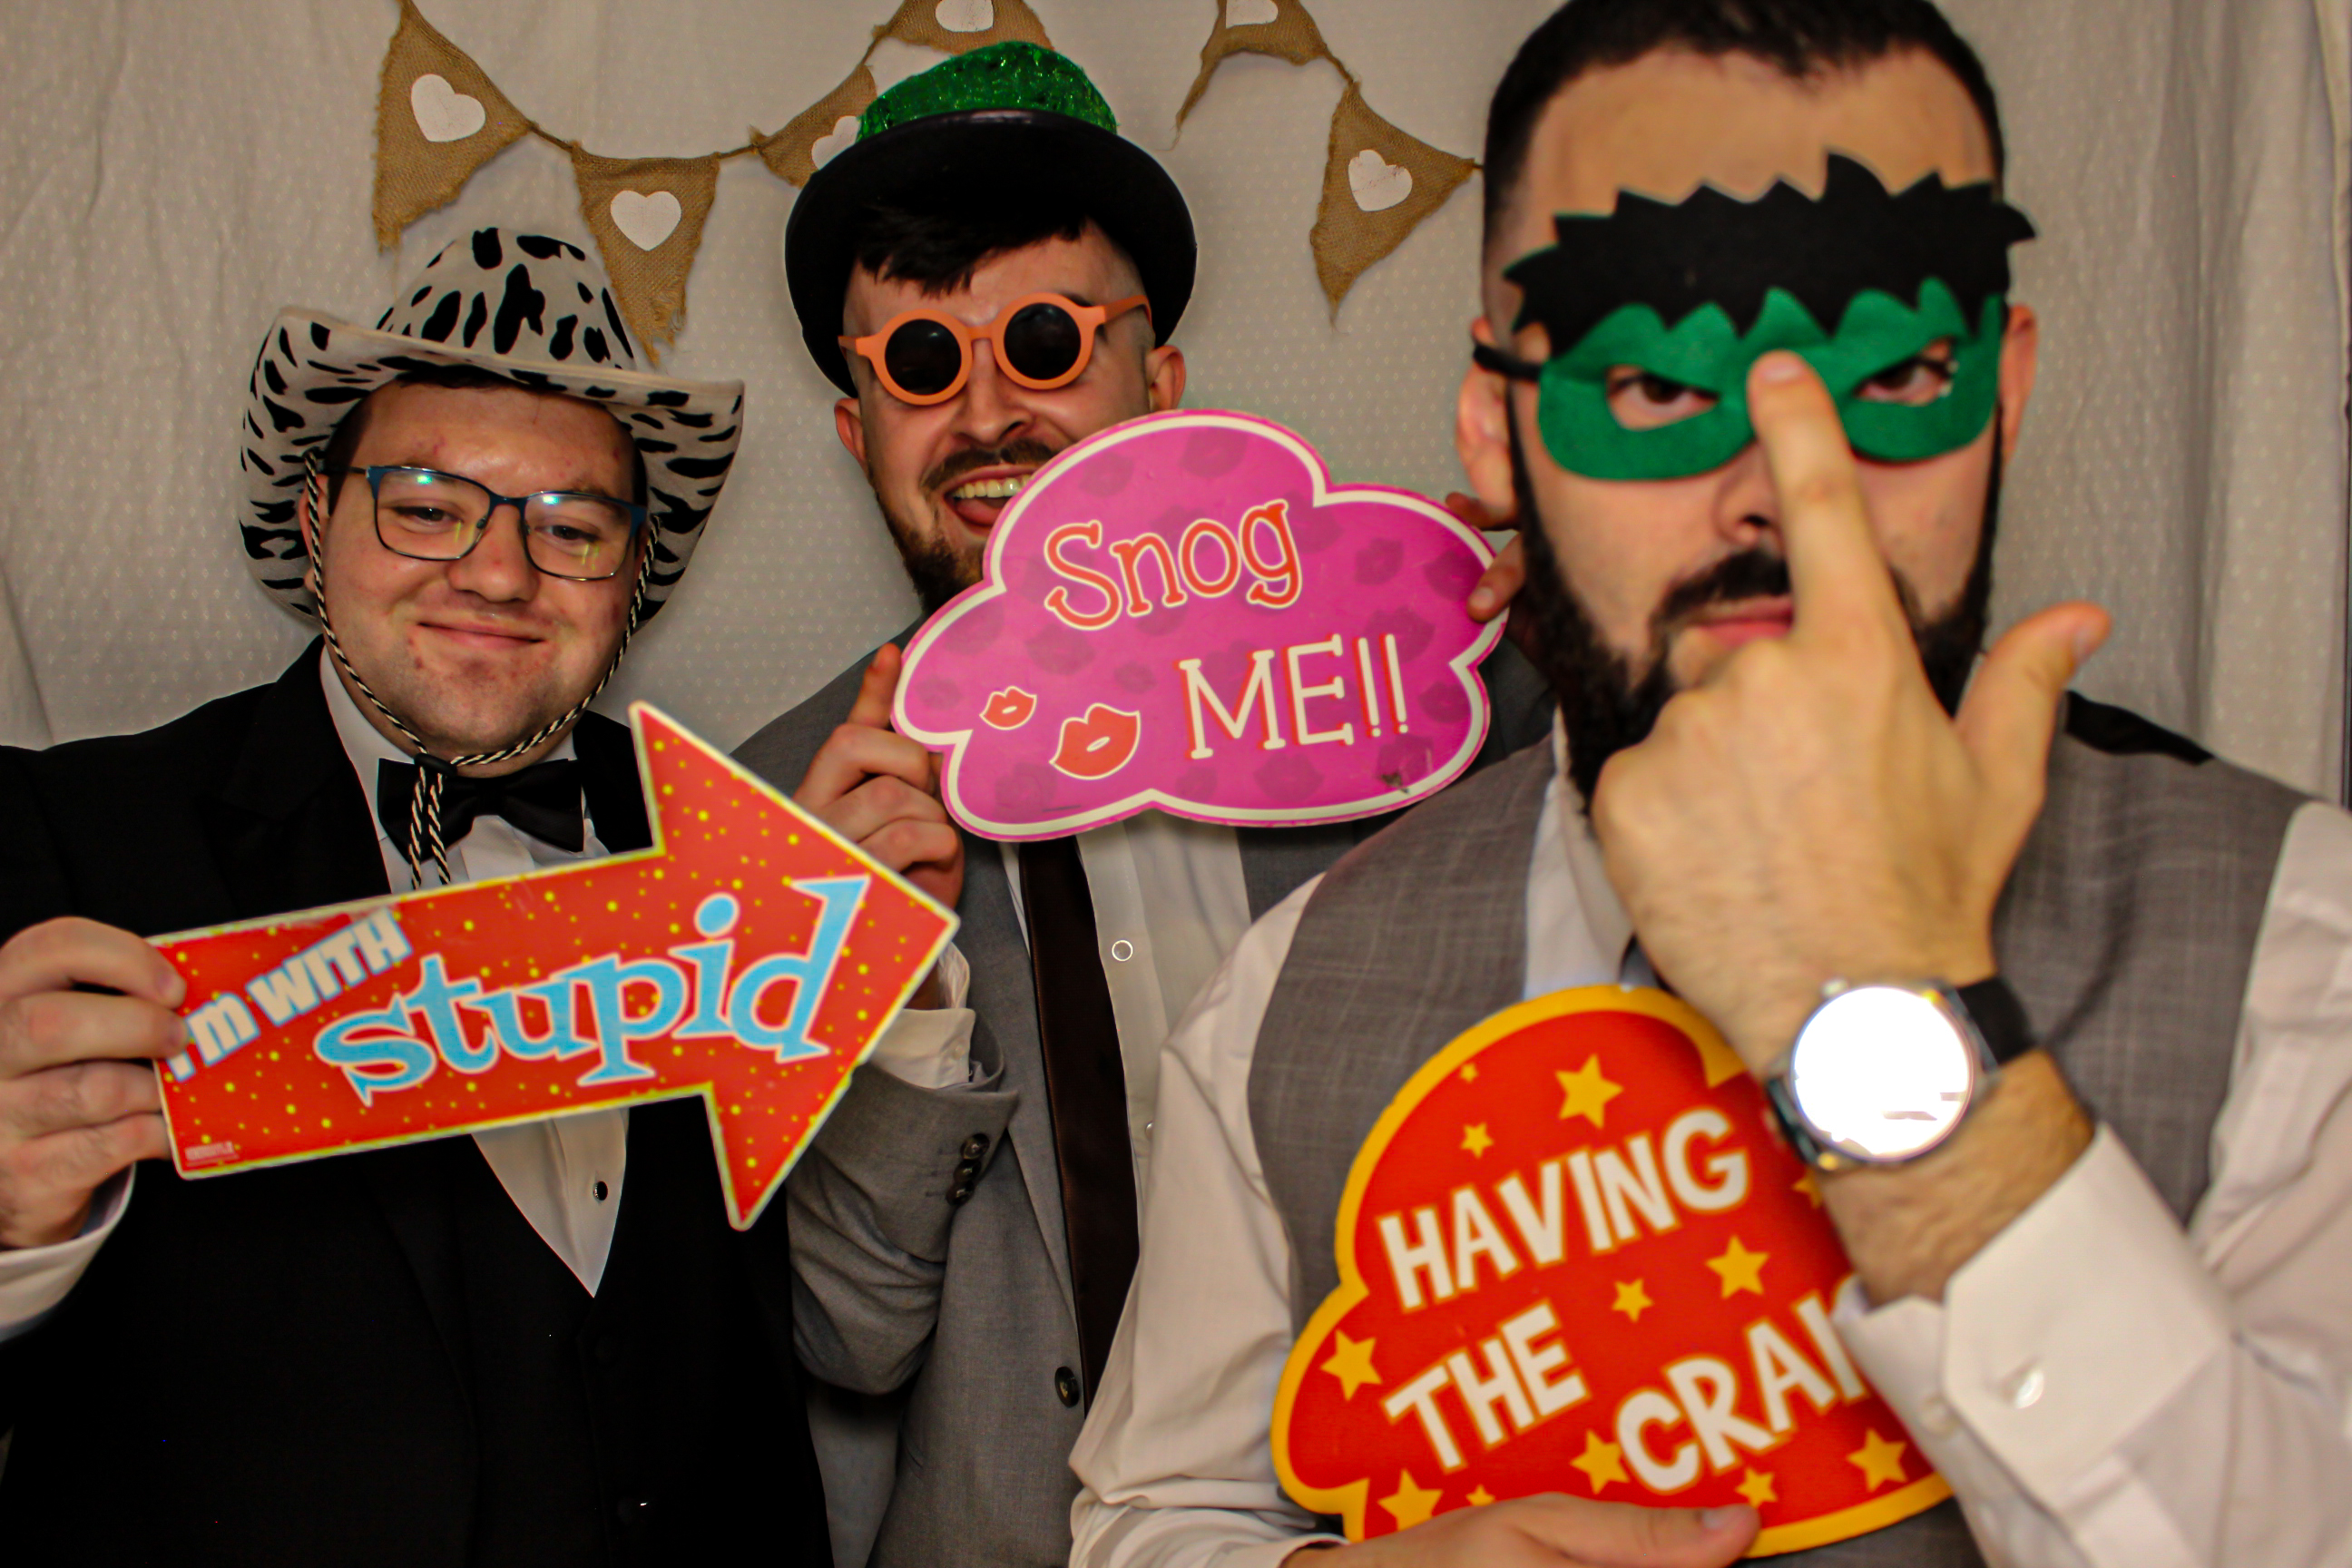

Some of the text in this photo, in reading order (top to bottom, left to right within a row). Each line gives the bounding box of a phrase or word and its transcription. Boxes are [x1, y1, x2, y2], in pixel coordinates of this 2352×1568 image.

[1044, 498, 1302, 631] Snog
[1174, 632, 1408, 760] ME!!
[245, 906, 413, 1026] WITH
[314, 876, 870, 1106] stupid
[1377, 1108, 1749, 1311] HAVING
[1382, 1301, 1591, 1472] THE
[1615, 1291, 1867, 1493] CRAI
